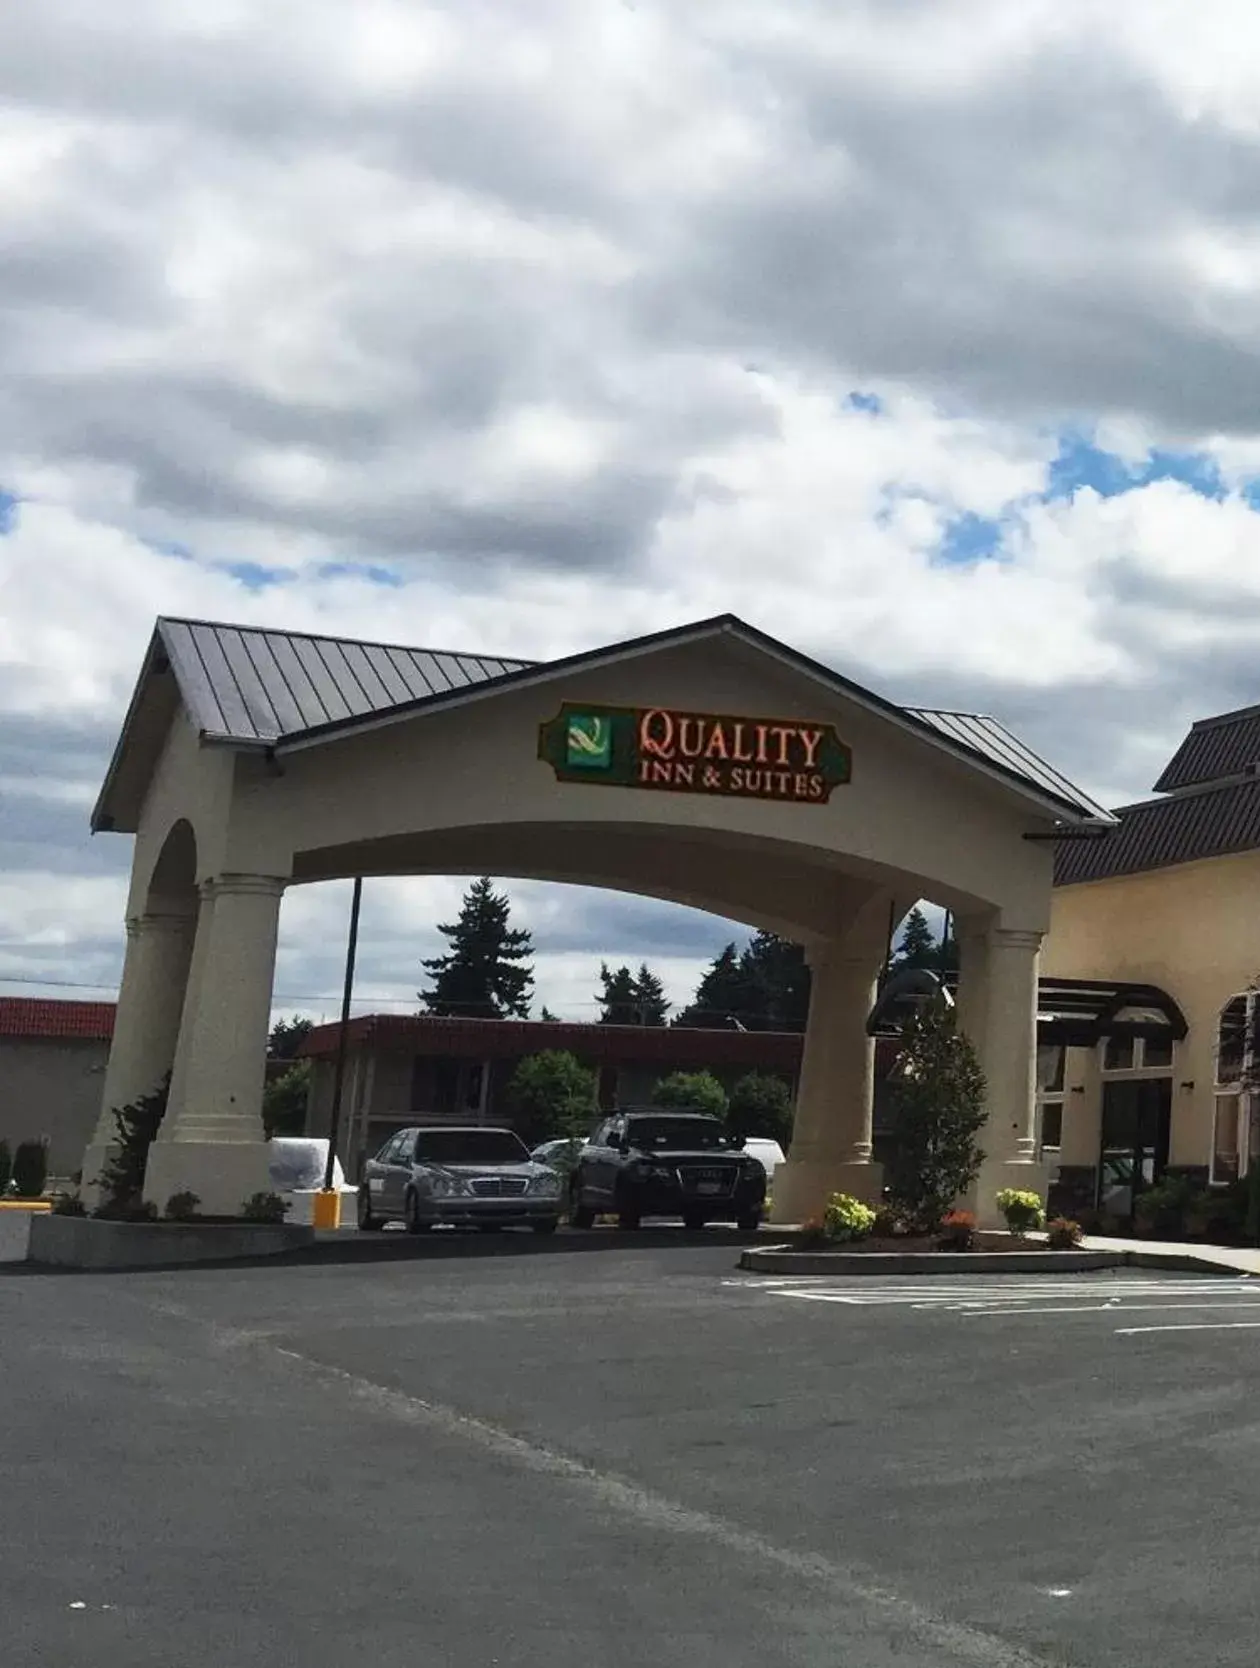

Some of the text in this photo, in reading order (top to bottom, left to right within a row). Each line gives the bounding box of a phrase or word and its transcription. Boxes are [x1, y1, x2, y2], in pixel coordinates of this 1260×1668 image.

[640, 709, 824, 767] QUALITY
[640, 759, 823, 798] INN & SUITES
